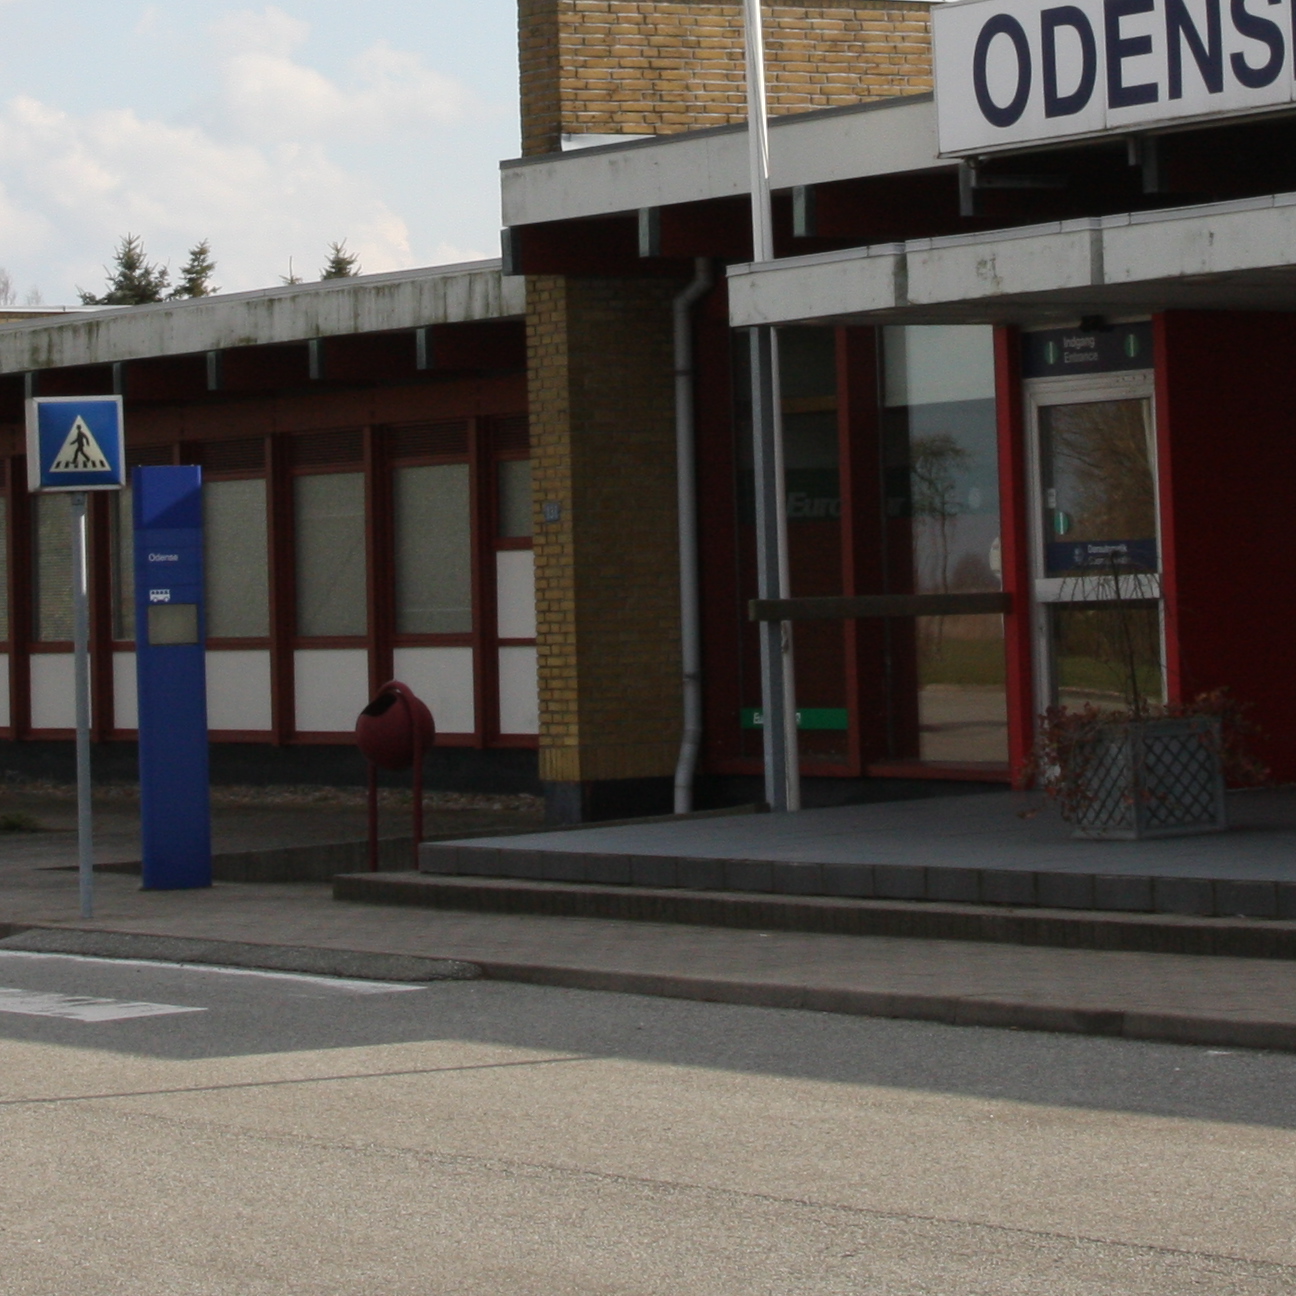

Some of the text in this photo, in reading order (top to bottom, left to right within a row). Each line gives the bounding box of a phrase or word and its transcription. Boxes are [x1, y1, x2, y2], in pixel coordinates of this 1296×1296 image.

[1063, 335, 1095, 349] Indgang
[1064, 351, 1099, 363] Entrance
[148, 553, 179, 562] Odense
